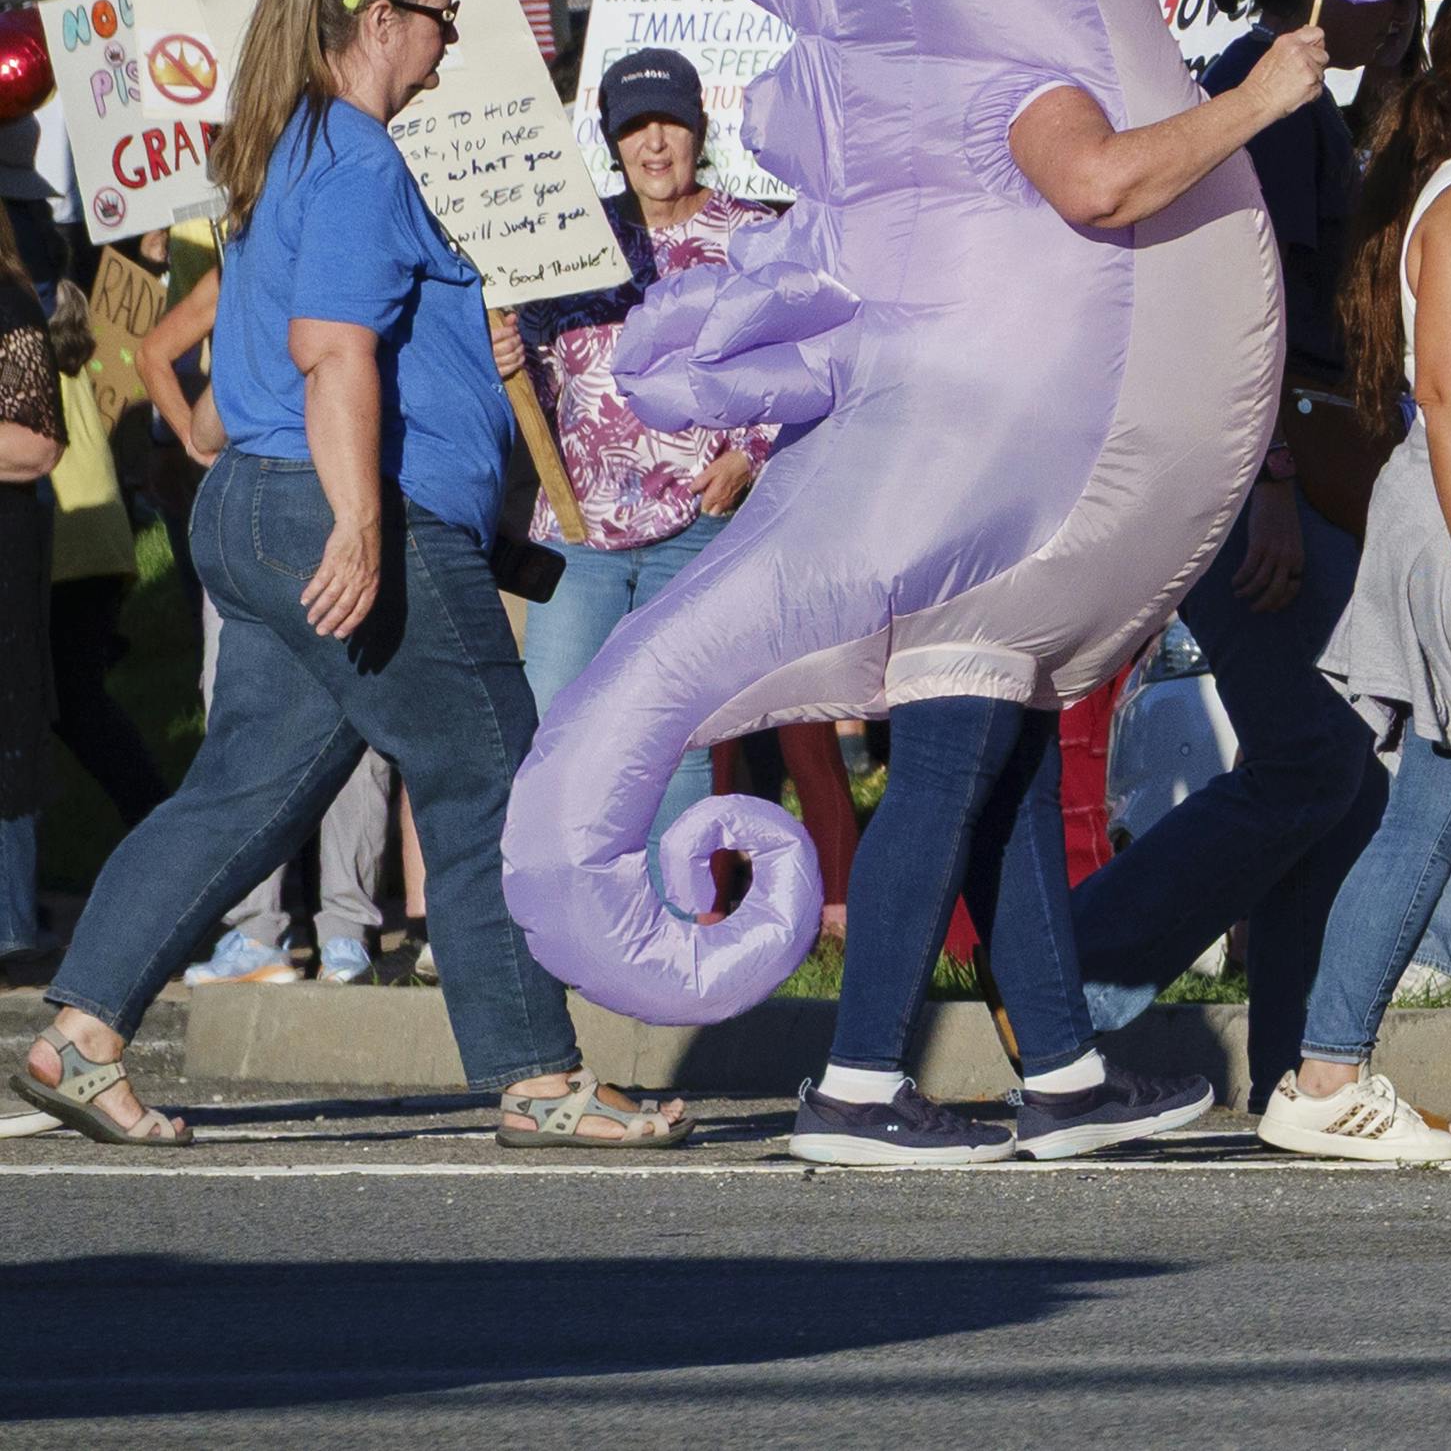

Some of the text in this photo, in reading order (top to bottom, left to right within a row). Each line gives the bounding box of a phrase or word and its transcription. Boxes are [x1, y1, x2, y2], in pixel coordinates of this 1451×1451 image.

[391, 97, 535, 141] EED TO HIDE
[404, 125, 545, 162] SK, YOU ARE
[524, 150, 562, 171] you
[715, 175, 741, 196] NO
[435, 196, 464, 217] WE
[481, 184, 523, 209] SEE
[458, 220, 492, 243] will
